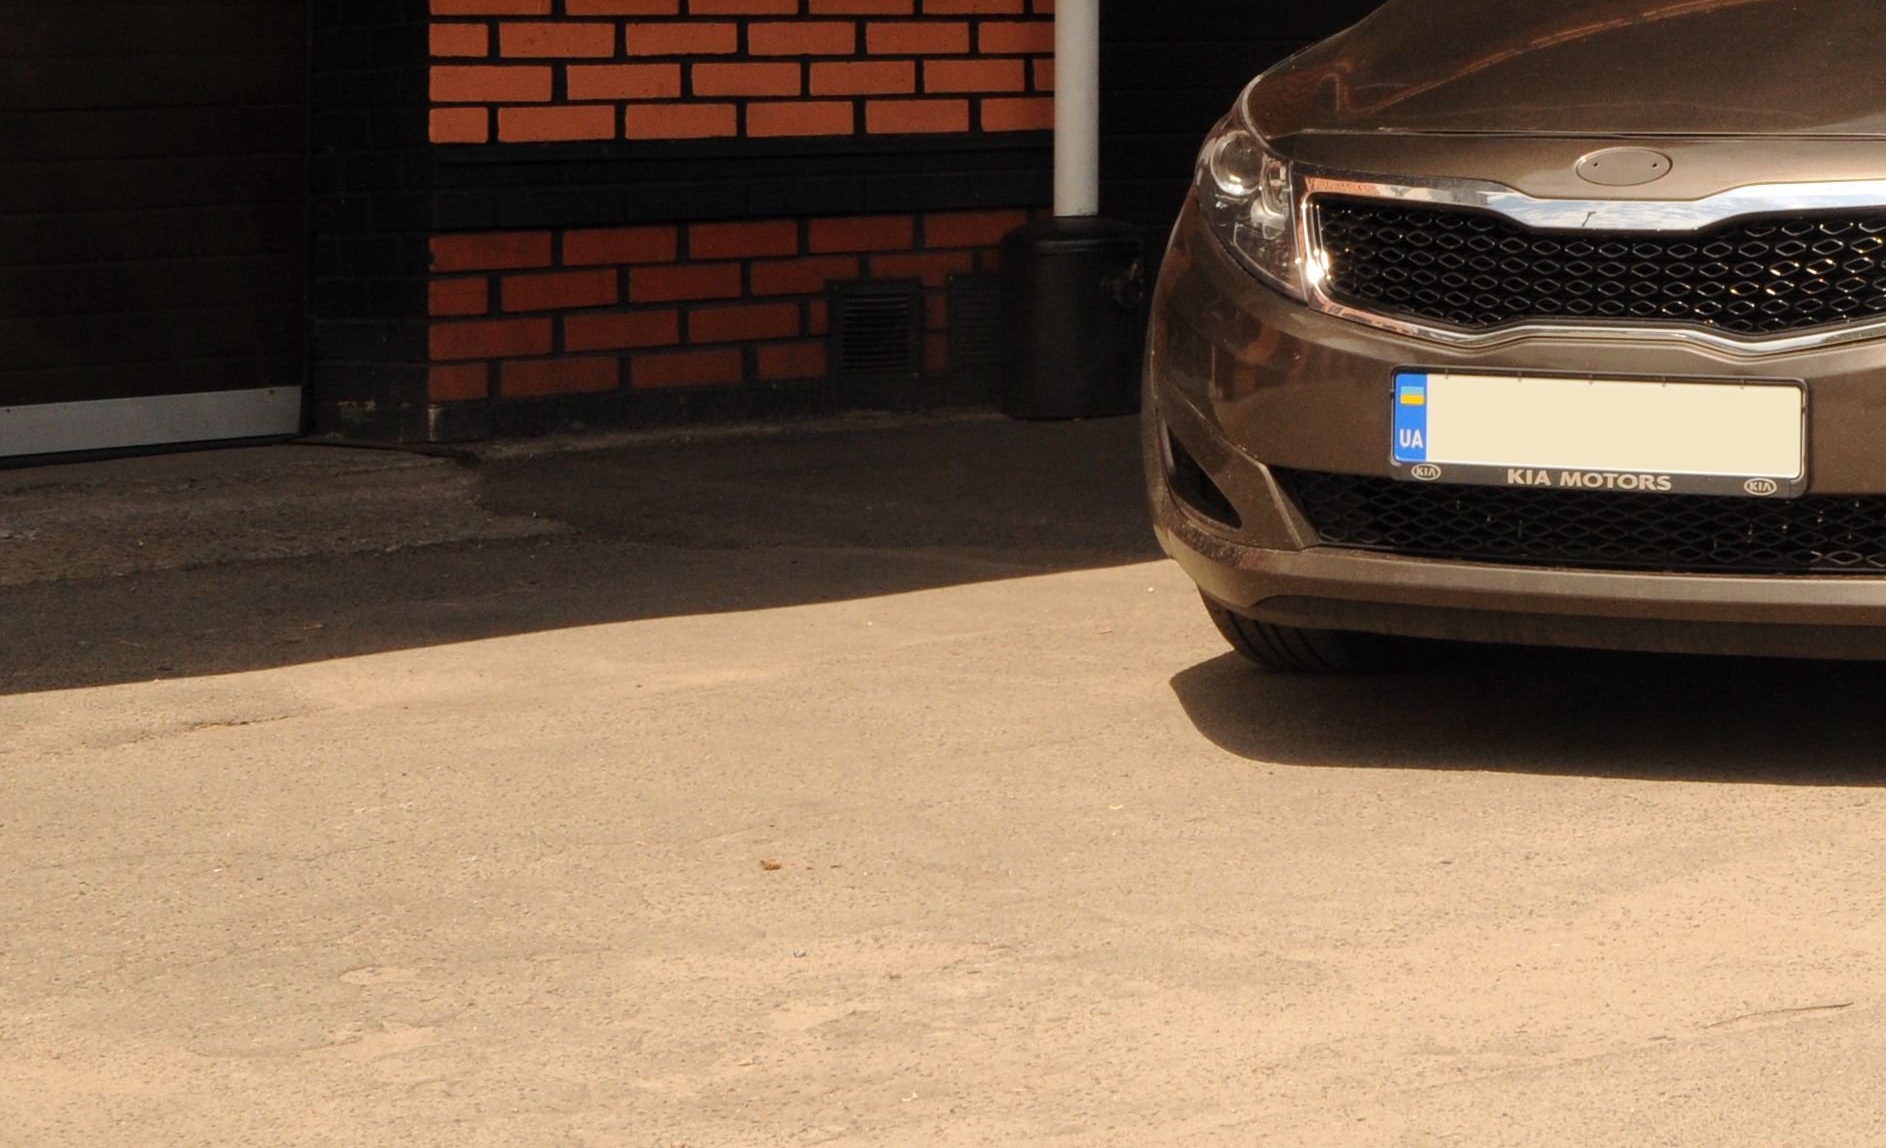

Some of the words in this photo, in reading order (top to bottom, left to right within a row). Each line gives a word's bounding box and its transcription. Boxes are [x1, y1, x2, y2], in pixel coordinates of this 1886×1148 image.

[1400, 428, 1424, 449] UA
[1507, 468, 1551, 486] KIA
[1560, 470, 1672, 492] MOTORS
